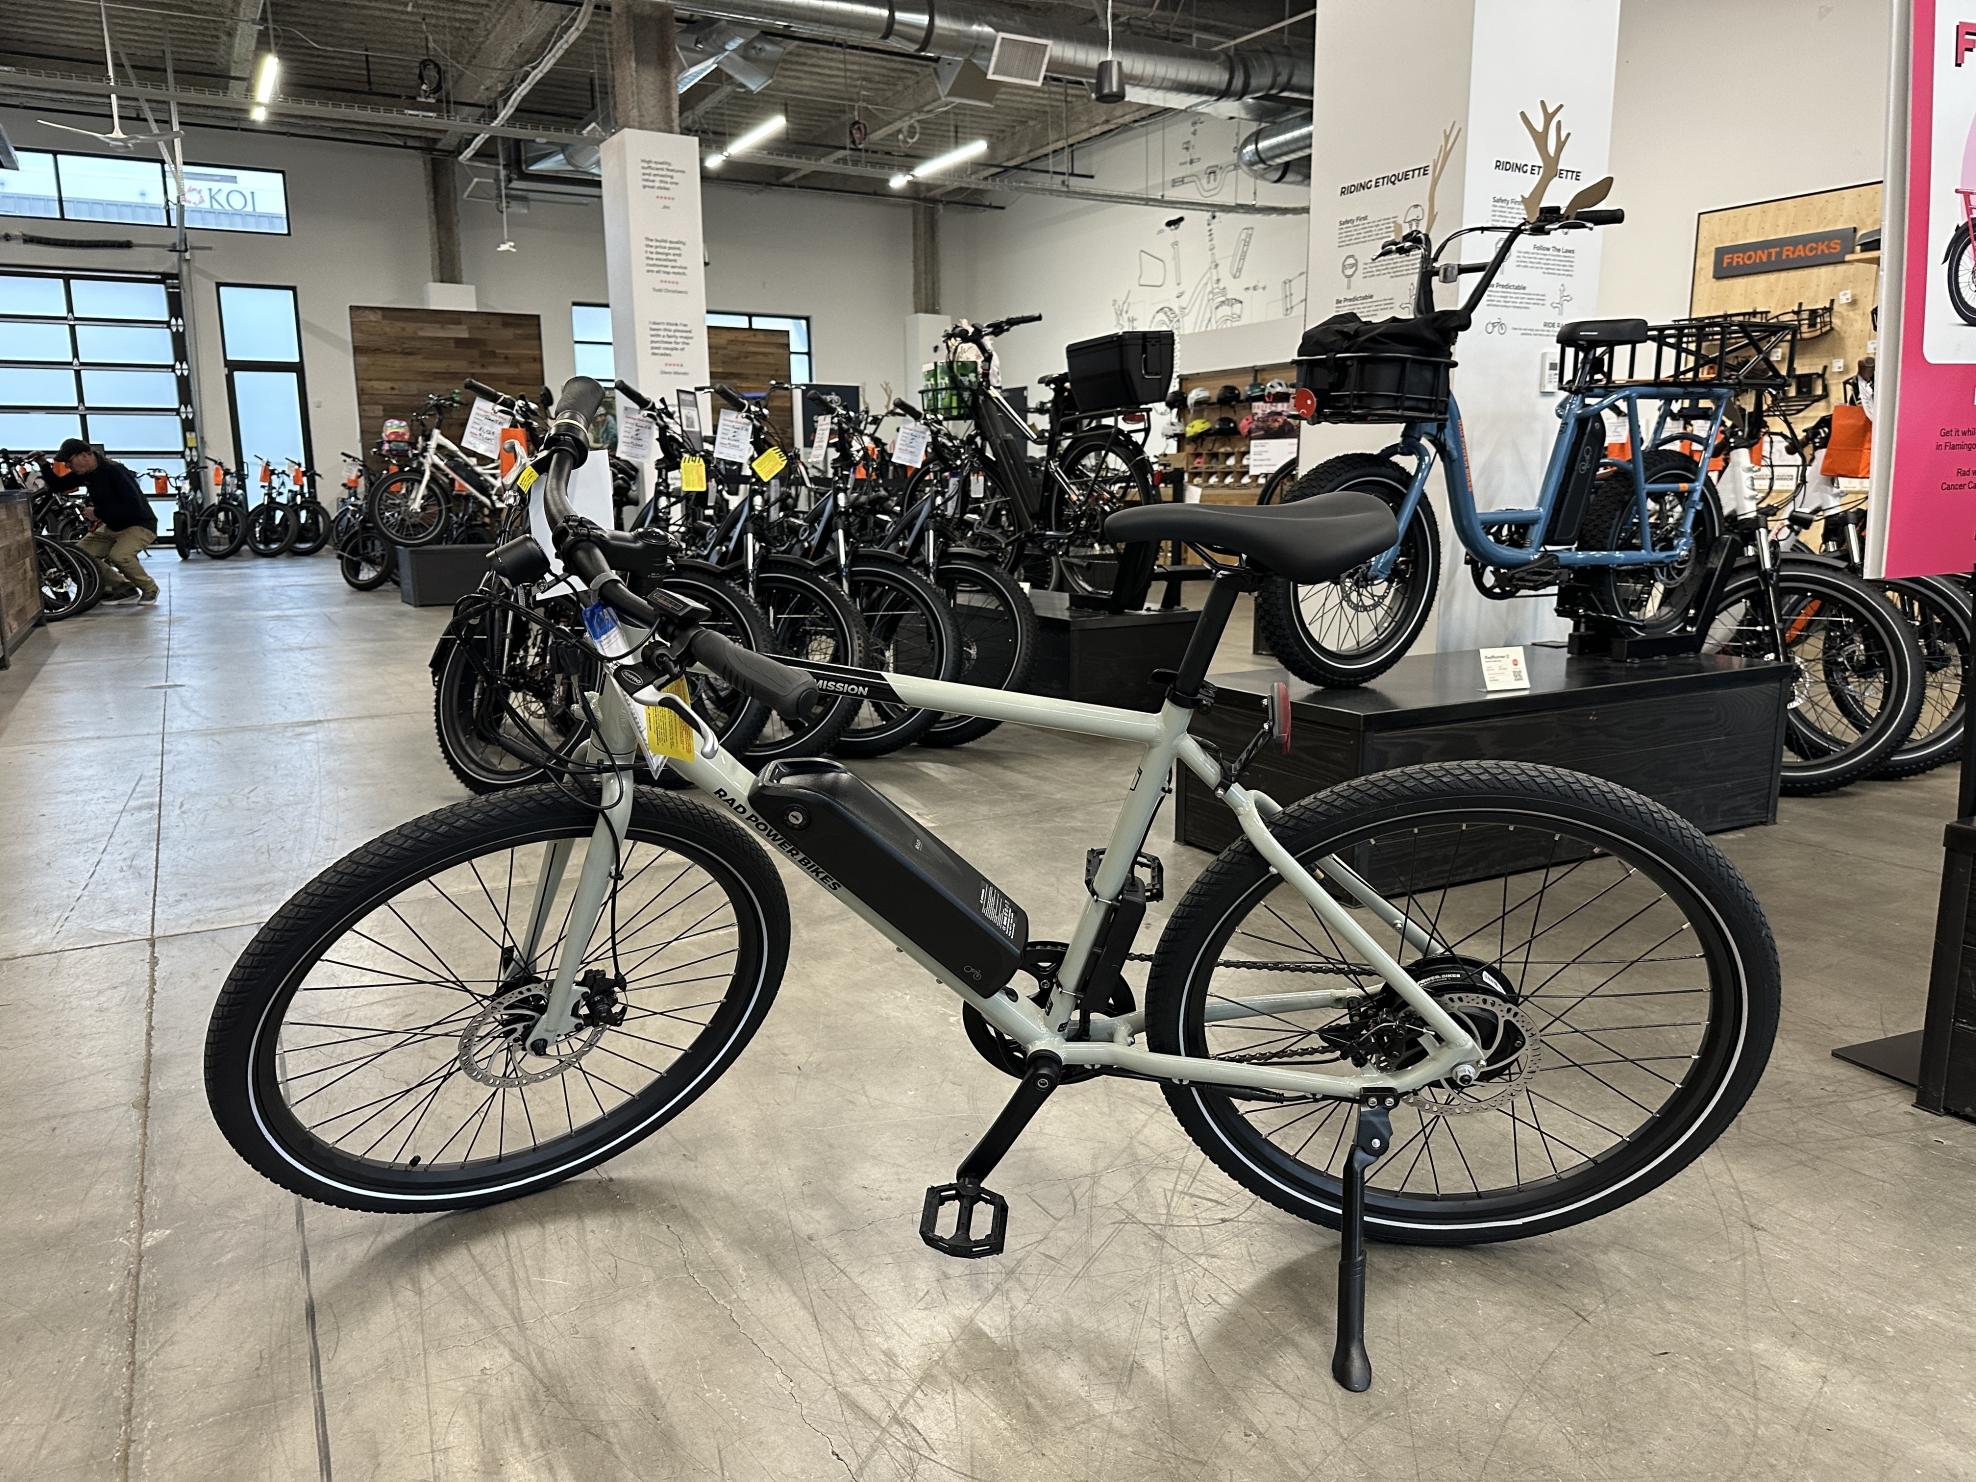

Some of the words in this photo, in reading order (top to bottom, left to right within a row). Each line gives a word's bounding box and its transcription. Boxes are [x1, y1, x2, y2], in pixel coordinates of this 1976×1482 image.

[1340, 180, 1373, 196] RIDING
[1374, 165, 1430, 186] ETIQUETTE
[1494, 160, 1528, 174] RIDING
[1530, 164, 1581, 181] ETETTE
[208, 187, 258, 212] KOI
[1722, 247, 1779, 268] FRONT
[1782, 239, 1842, 260] RACKS
[1940, 428, 1953, 437] Get
[1954, 428, 1960, 437] it
[1936, 442, 1943, 451] in
[1956, 468, 1971, 477] Rad
[1940, 481, 1967, 491] Cancer
[713, 787, 747, 815] RAD
[745, 813, 800, 860] POWER
[798, 856, 842, 891] BIKES
